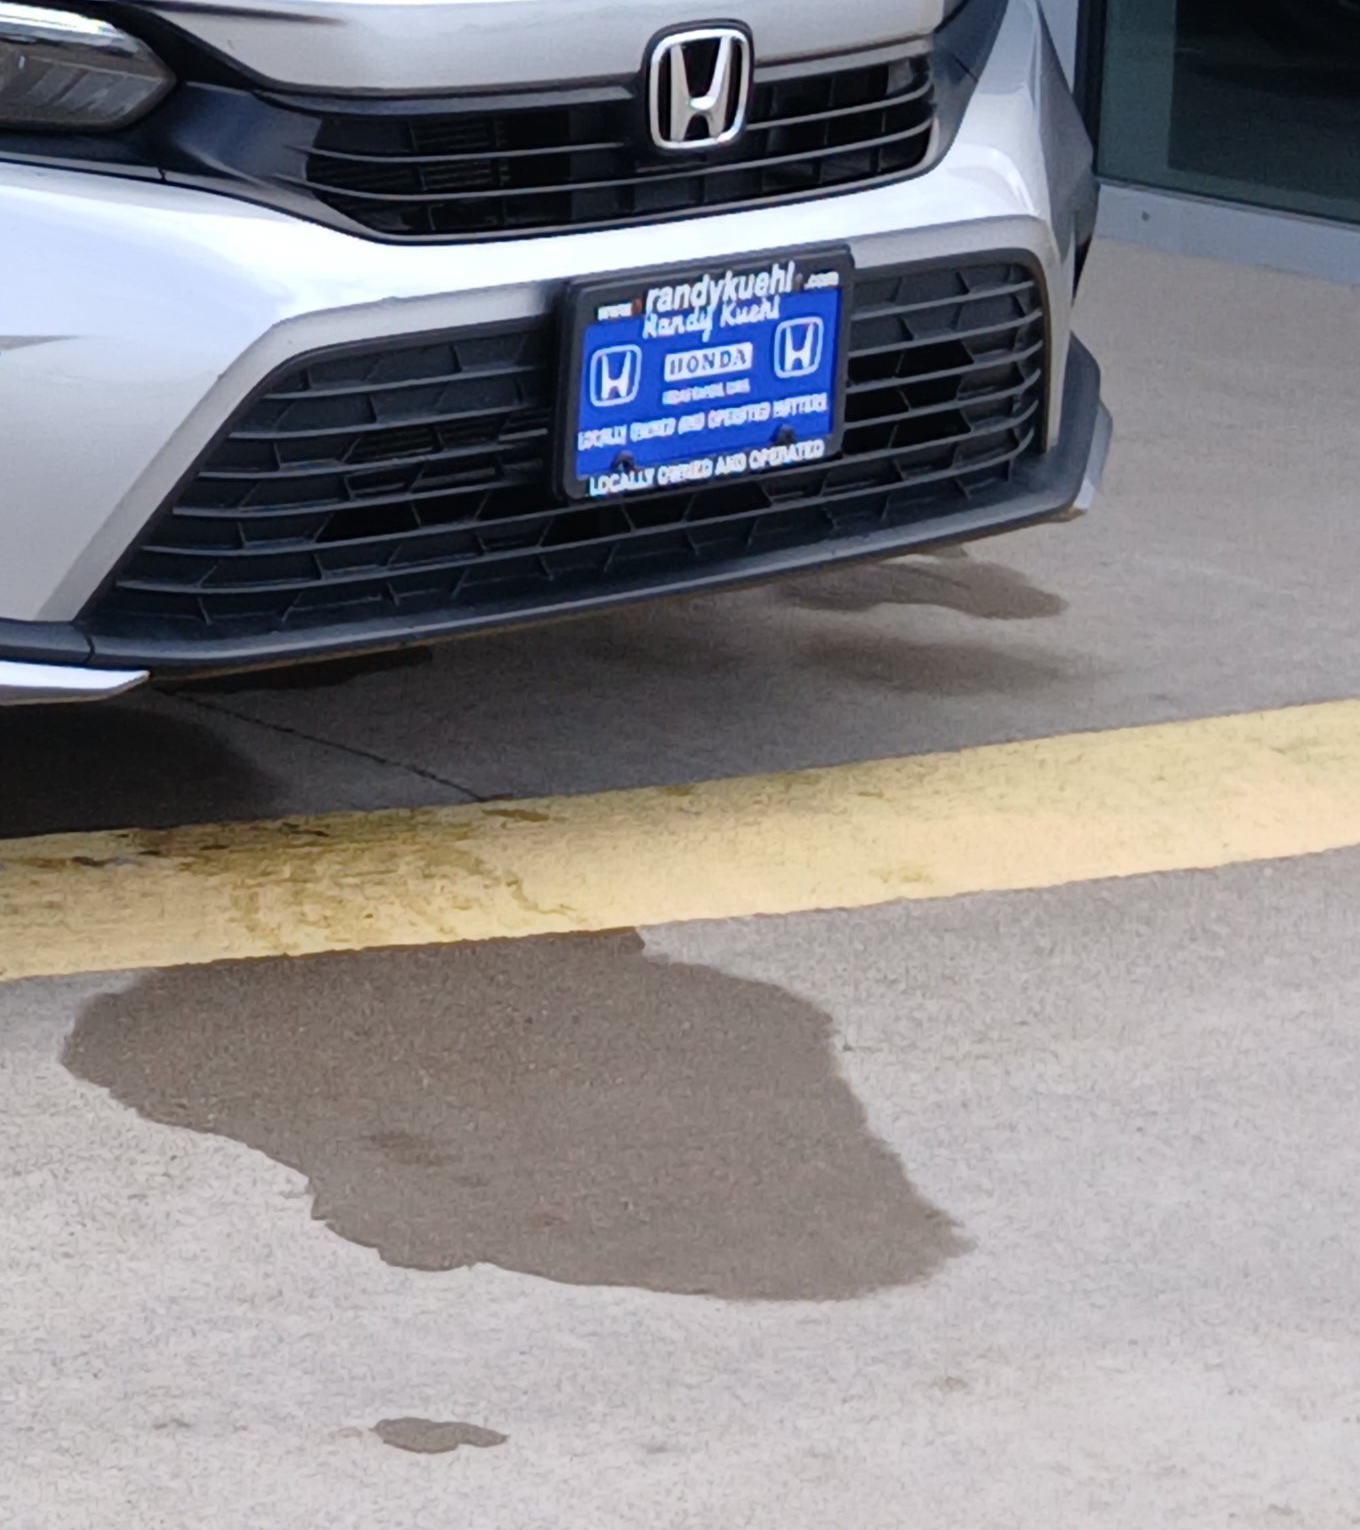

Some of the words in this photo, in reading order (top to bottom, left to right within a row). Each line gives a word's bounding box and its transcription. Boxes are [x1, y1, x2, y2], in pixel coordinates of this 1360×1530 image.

[642, 310, 715, 343] Randy
[720, 296, 780, 328] Kuehl
[670, 347, 748, 376] HONDA
[589, 467, 655, 497] LOCALLY
[657, 459, 712, 486] OWNED
[715, 453, 746, 477] AND
[749, 439, 825, 470] OPERATED
